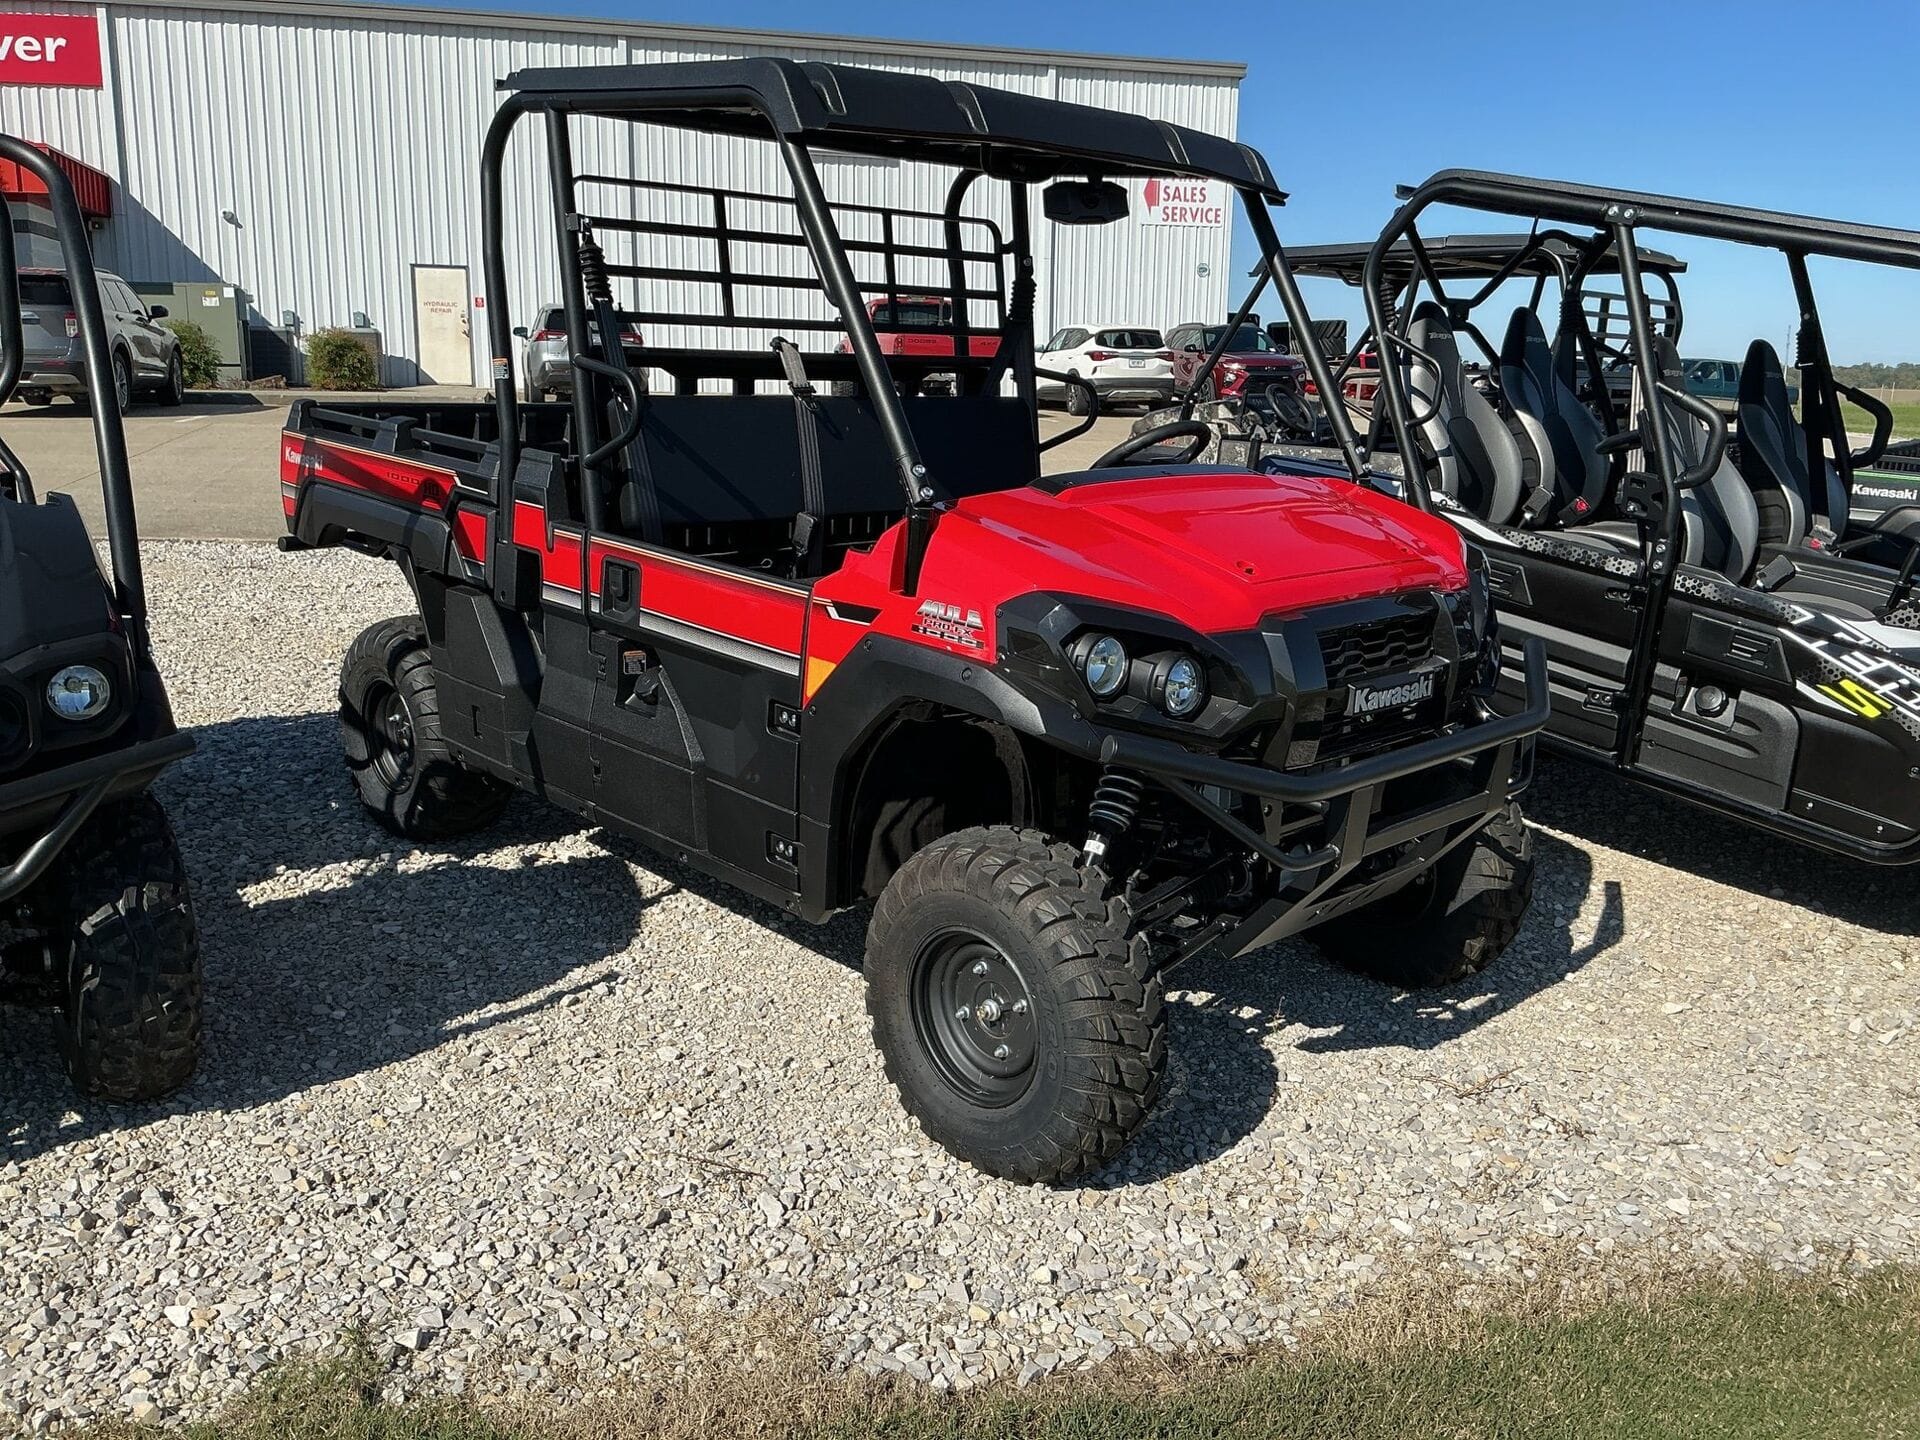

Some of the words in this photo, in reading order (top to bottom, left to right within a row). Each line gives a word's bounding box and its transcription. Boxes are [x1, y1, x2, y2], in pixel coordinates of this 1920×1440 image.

[1162, 185, 1207, 203] SALES
[1161, 206, 1222, 224] SERVICE
[285, 445, 323, 471] Kawasaki
[1851, 483, 1918, 500] Kawasaki
[1353, 673, 1434, 714] Kawasaki
